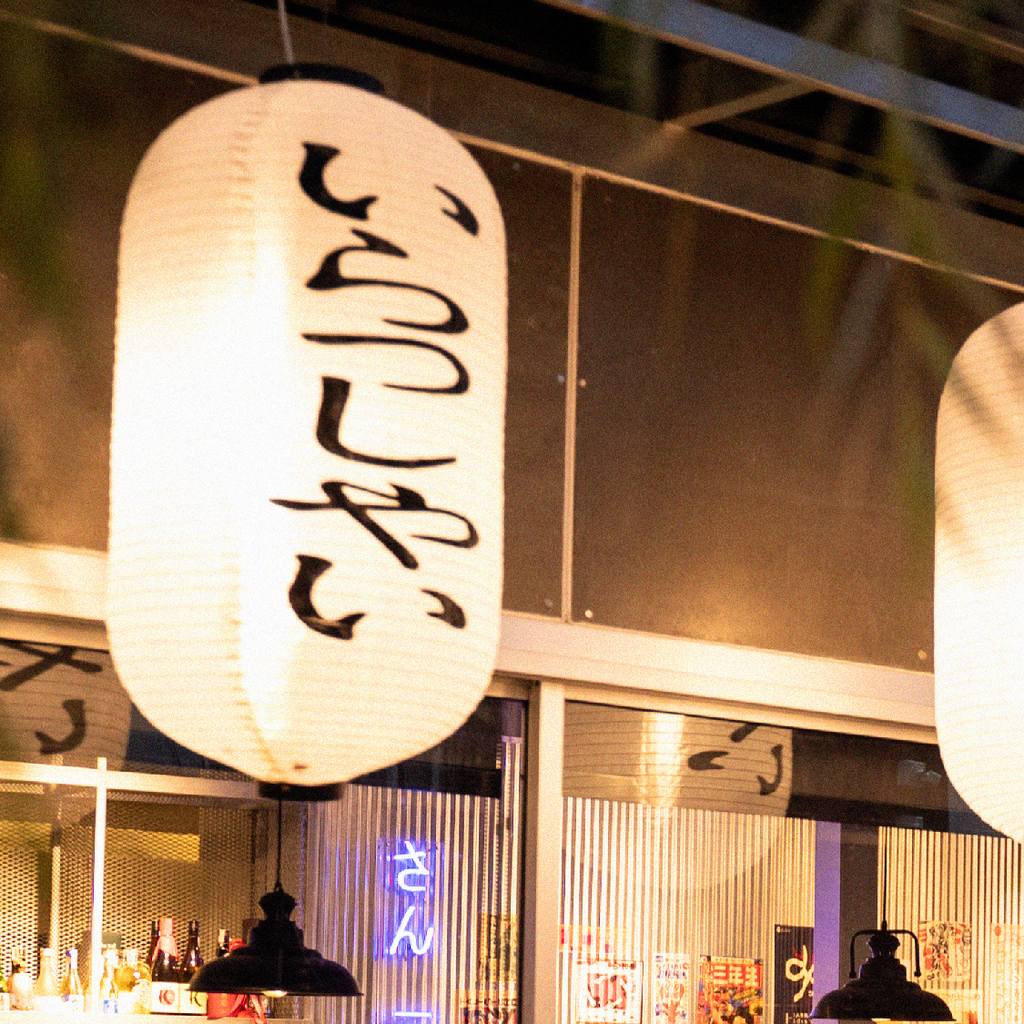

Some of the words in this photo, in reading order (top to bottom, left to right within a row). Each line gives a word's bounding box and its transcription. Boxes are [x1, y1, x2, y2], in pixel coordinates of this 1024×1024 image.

[271, 142, 480, 641] いらっしゃい
[389, 841, 434, 956] さん
